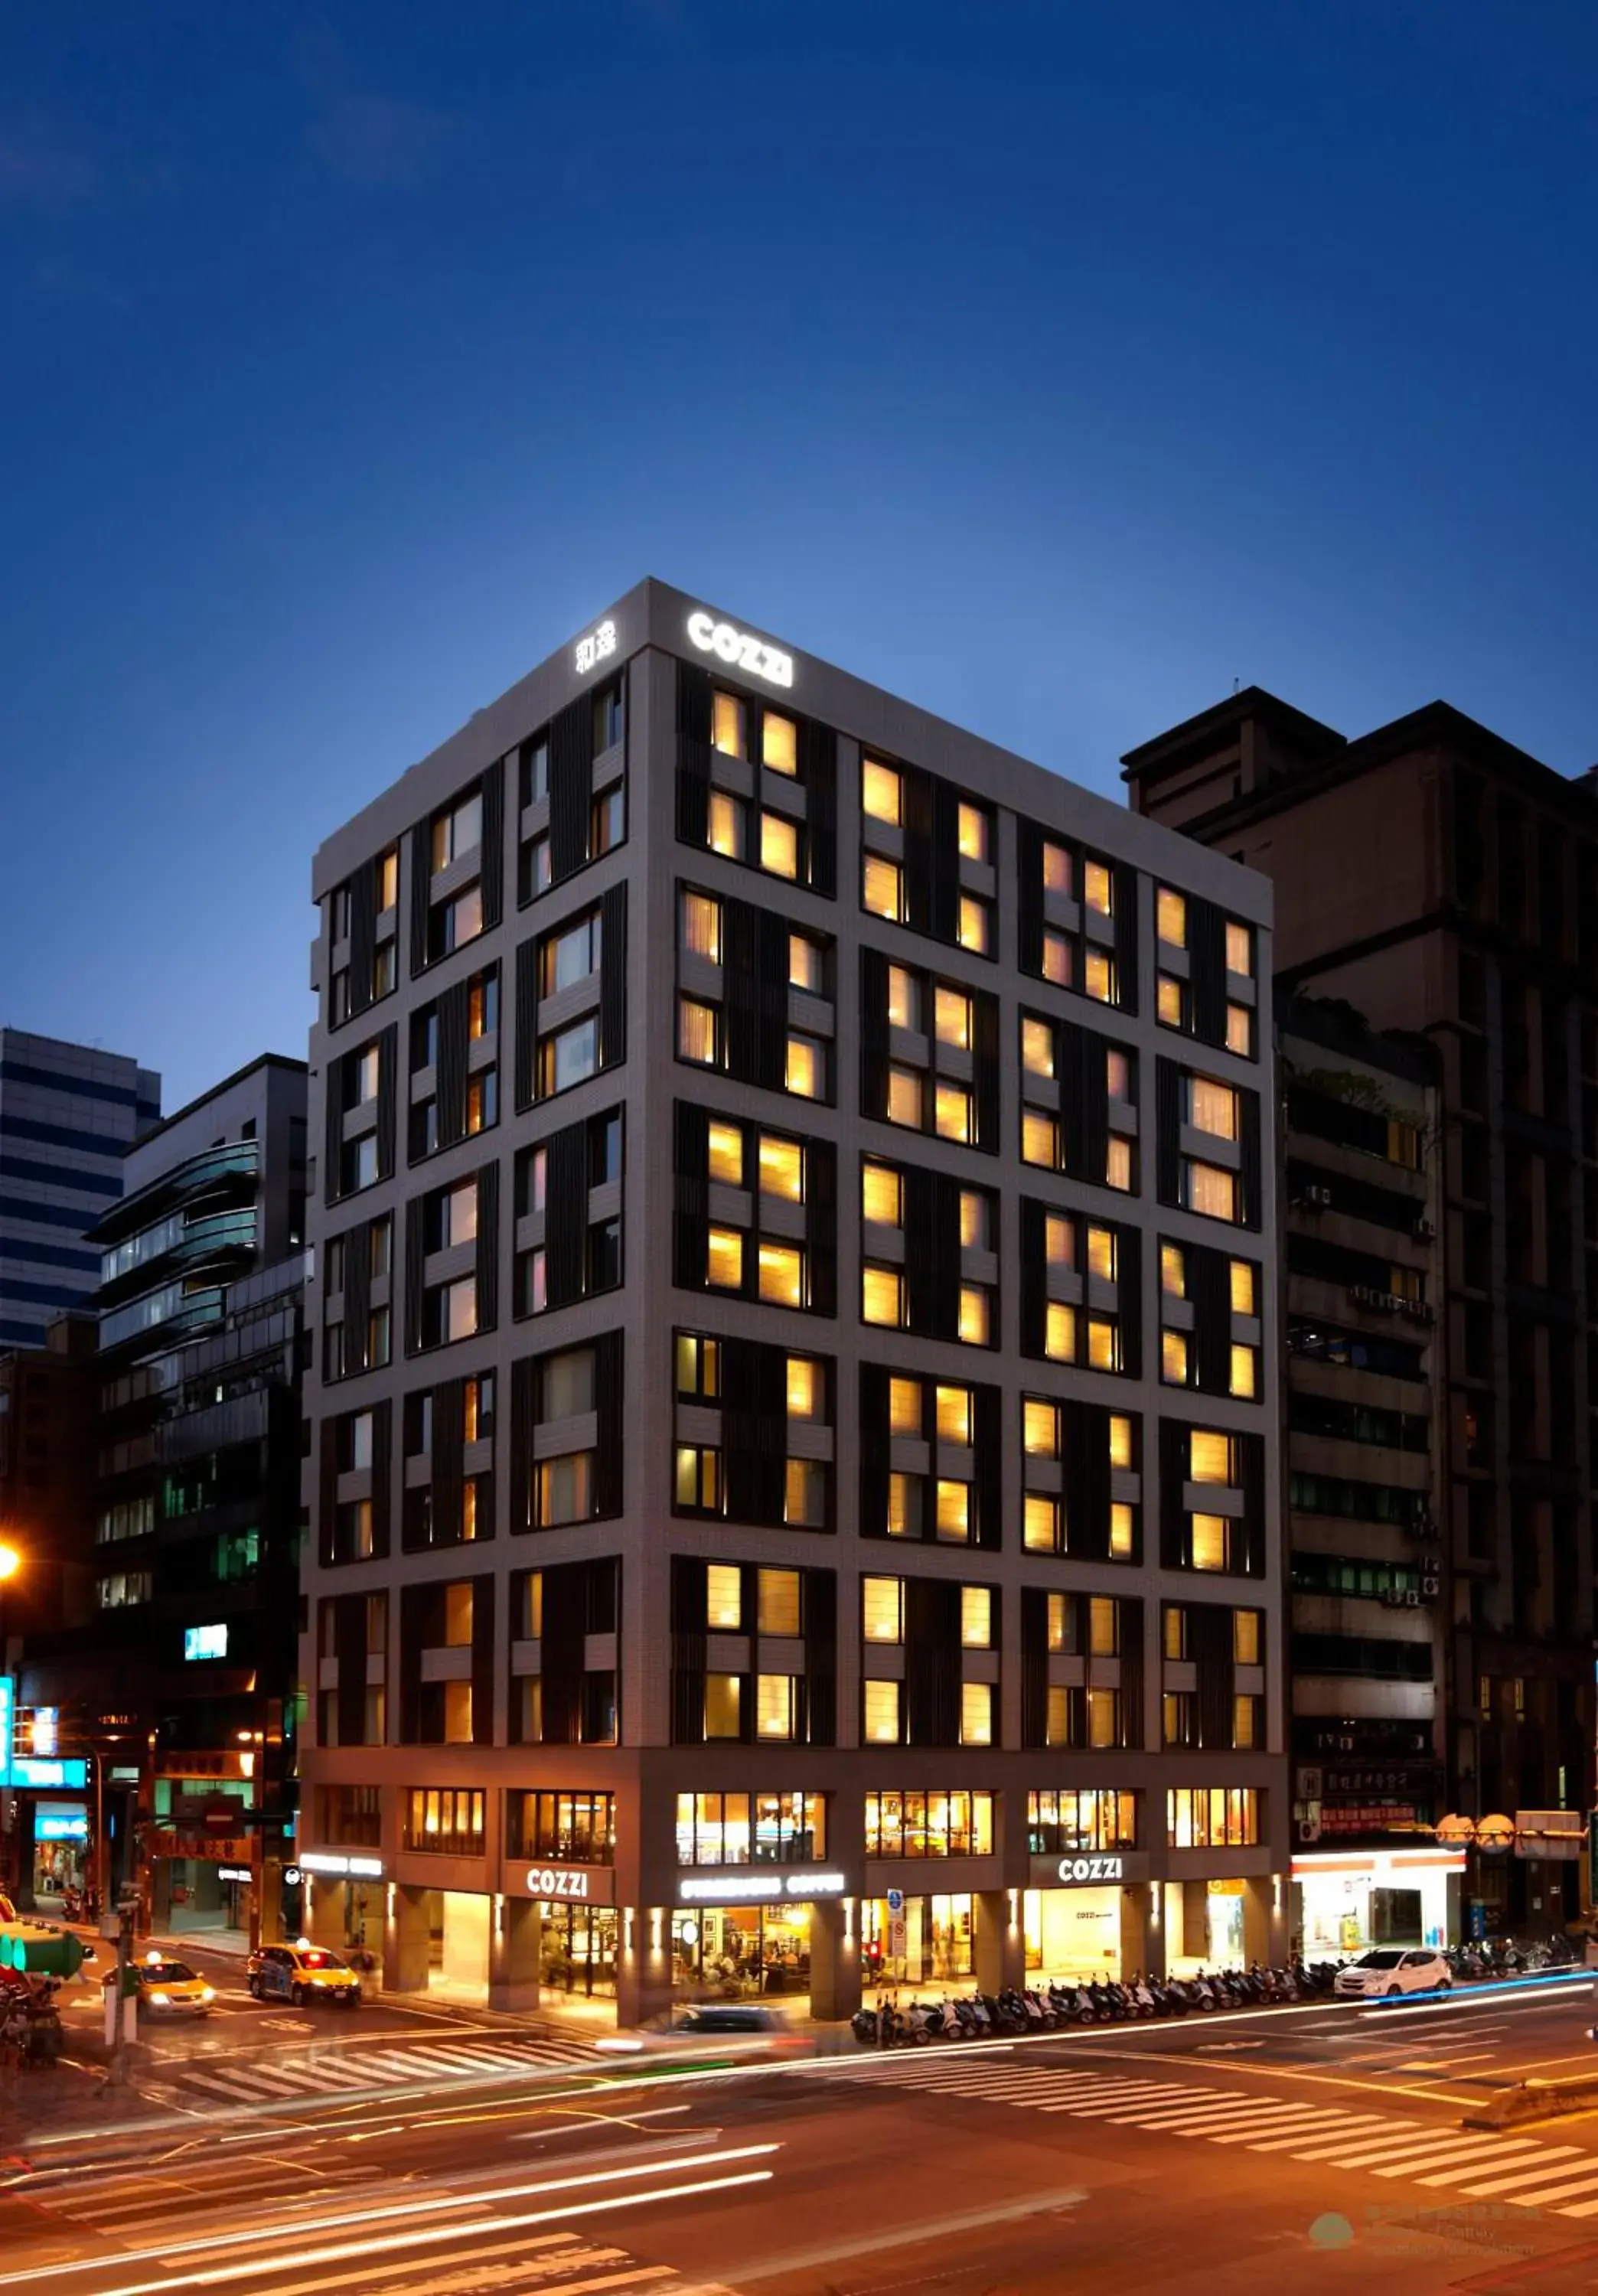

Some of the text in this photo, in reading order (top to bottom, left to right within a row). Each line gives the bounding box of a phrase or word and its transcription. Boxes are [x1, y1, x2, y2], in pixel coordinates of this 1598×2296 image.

[687, 612, 793, 688] COZZI
[527, 1868, 587, 1897] COZZI
[1058, 1857, 1122, 1881] COZZI
